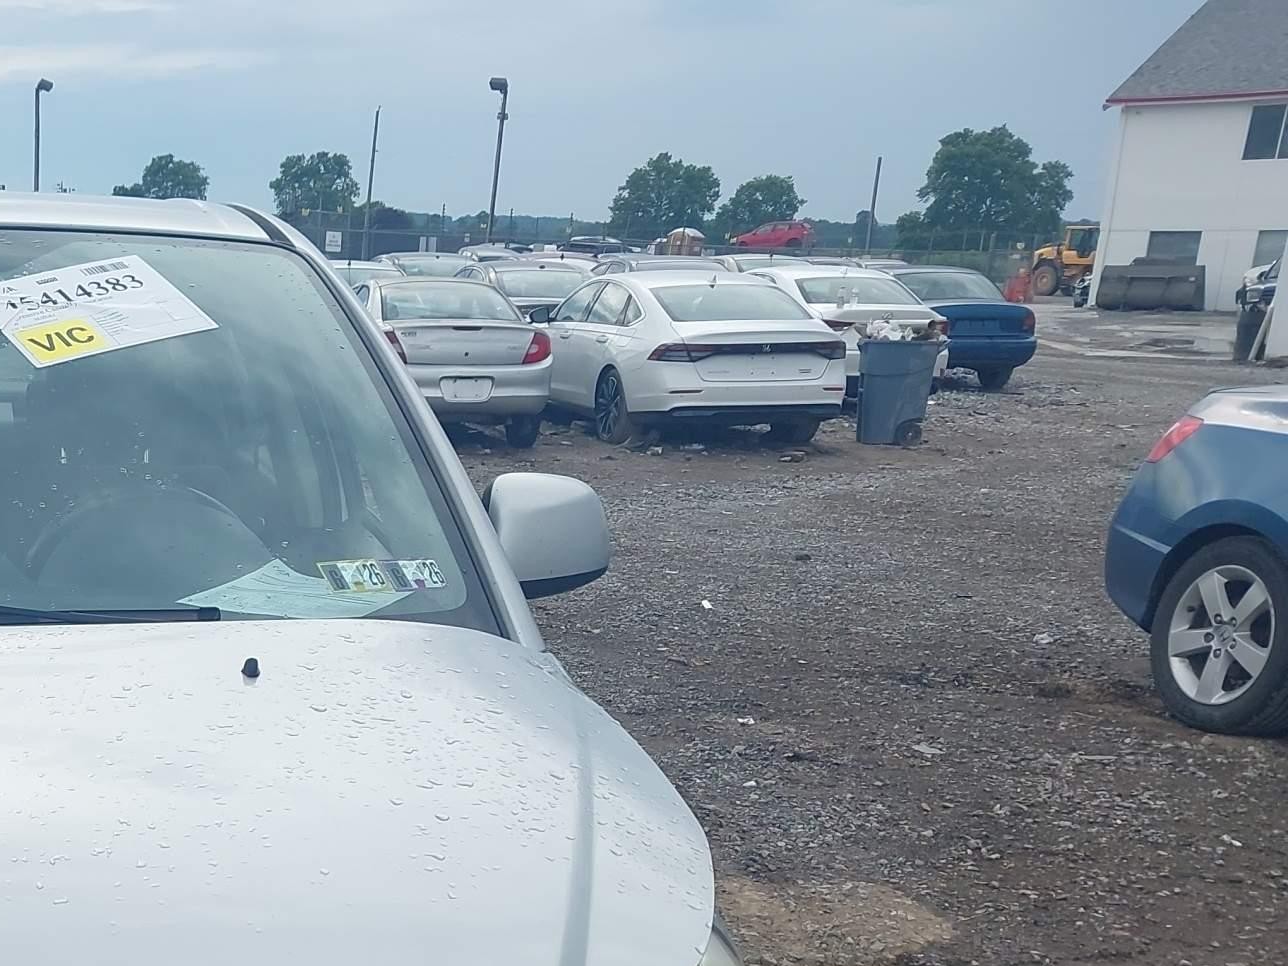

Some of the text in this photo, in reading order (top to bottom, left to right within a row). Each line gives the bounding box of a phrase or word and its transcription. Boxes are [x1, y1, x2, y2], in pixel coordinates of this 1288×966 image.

[27, 326, 95, 352] VIC
[362, 563, 386, 586] 26
[422, 561, 446, 585] 26
